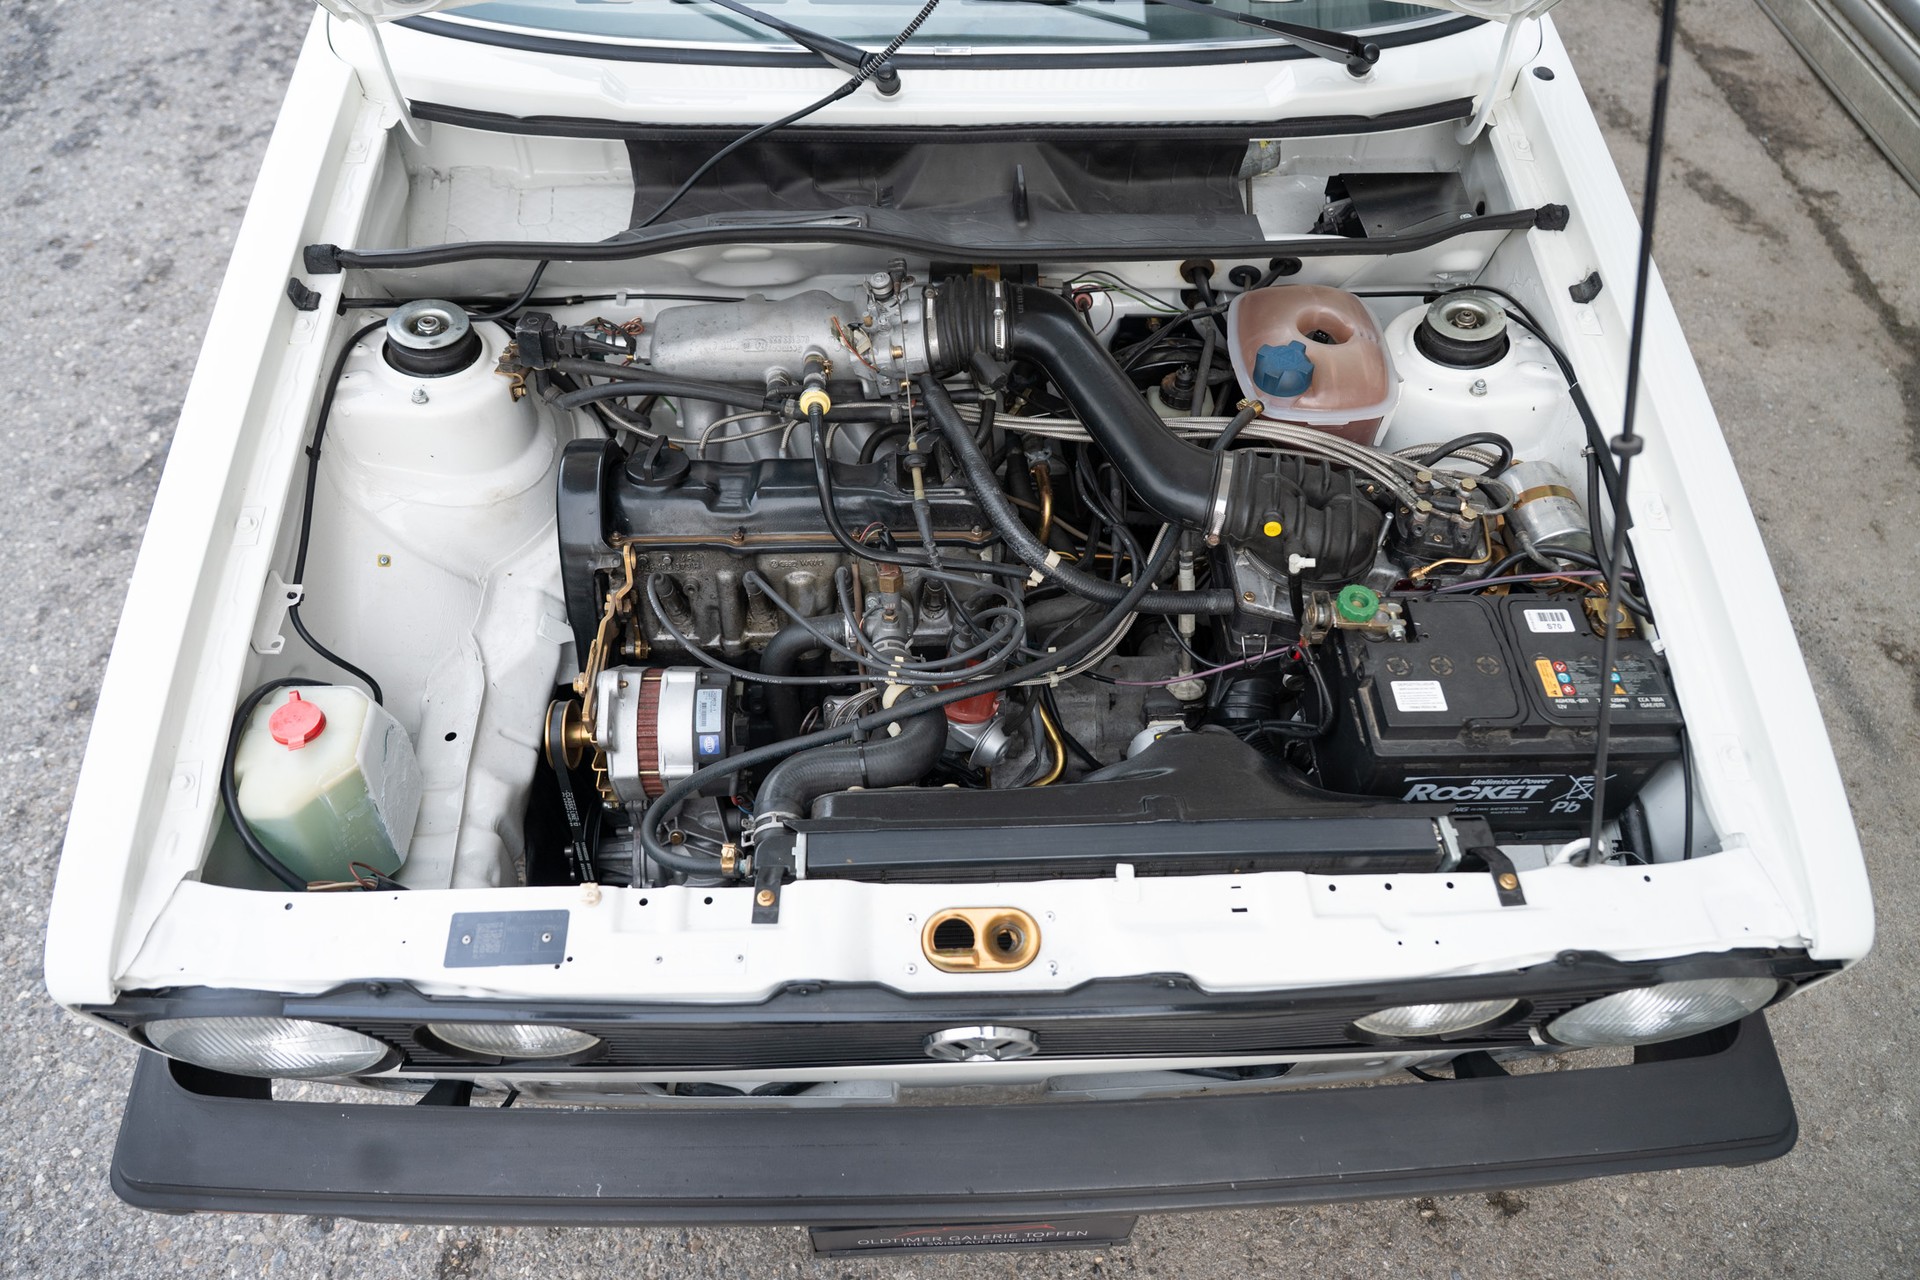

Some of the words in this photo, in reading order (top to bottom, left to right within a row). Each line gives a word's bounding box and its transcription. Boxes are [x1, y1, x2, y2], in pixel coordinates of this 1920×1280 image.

[1470, 778, 1519, 786] Unlimited
[1549, 801, 1581, 814] Pb
[857, 1235, 942, 1245] OLDTIMER
[949, 1232, 1018, 1241] GALERIE
[1024, 1230, 1089, 1238] TOFFEN
[964, 1237, 1044, 1246] AUCTIONEERS
